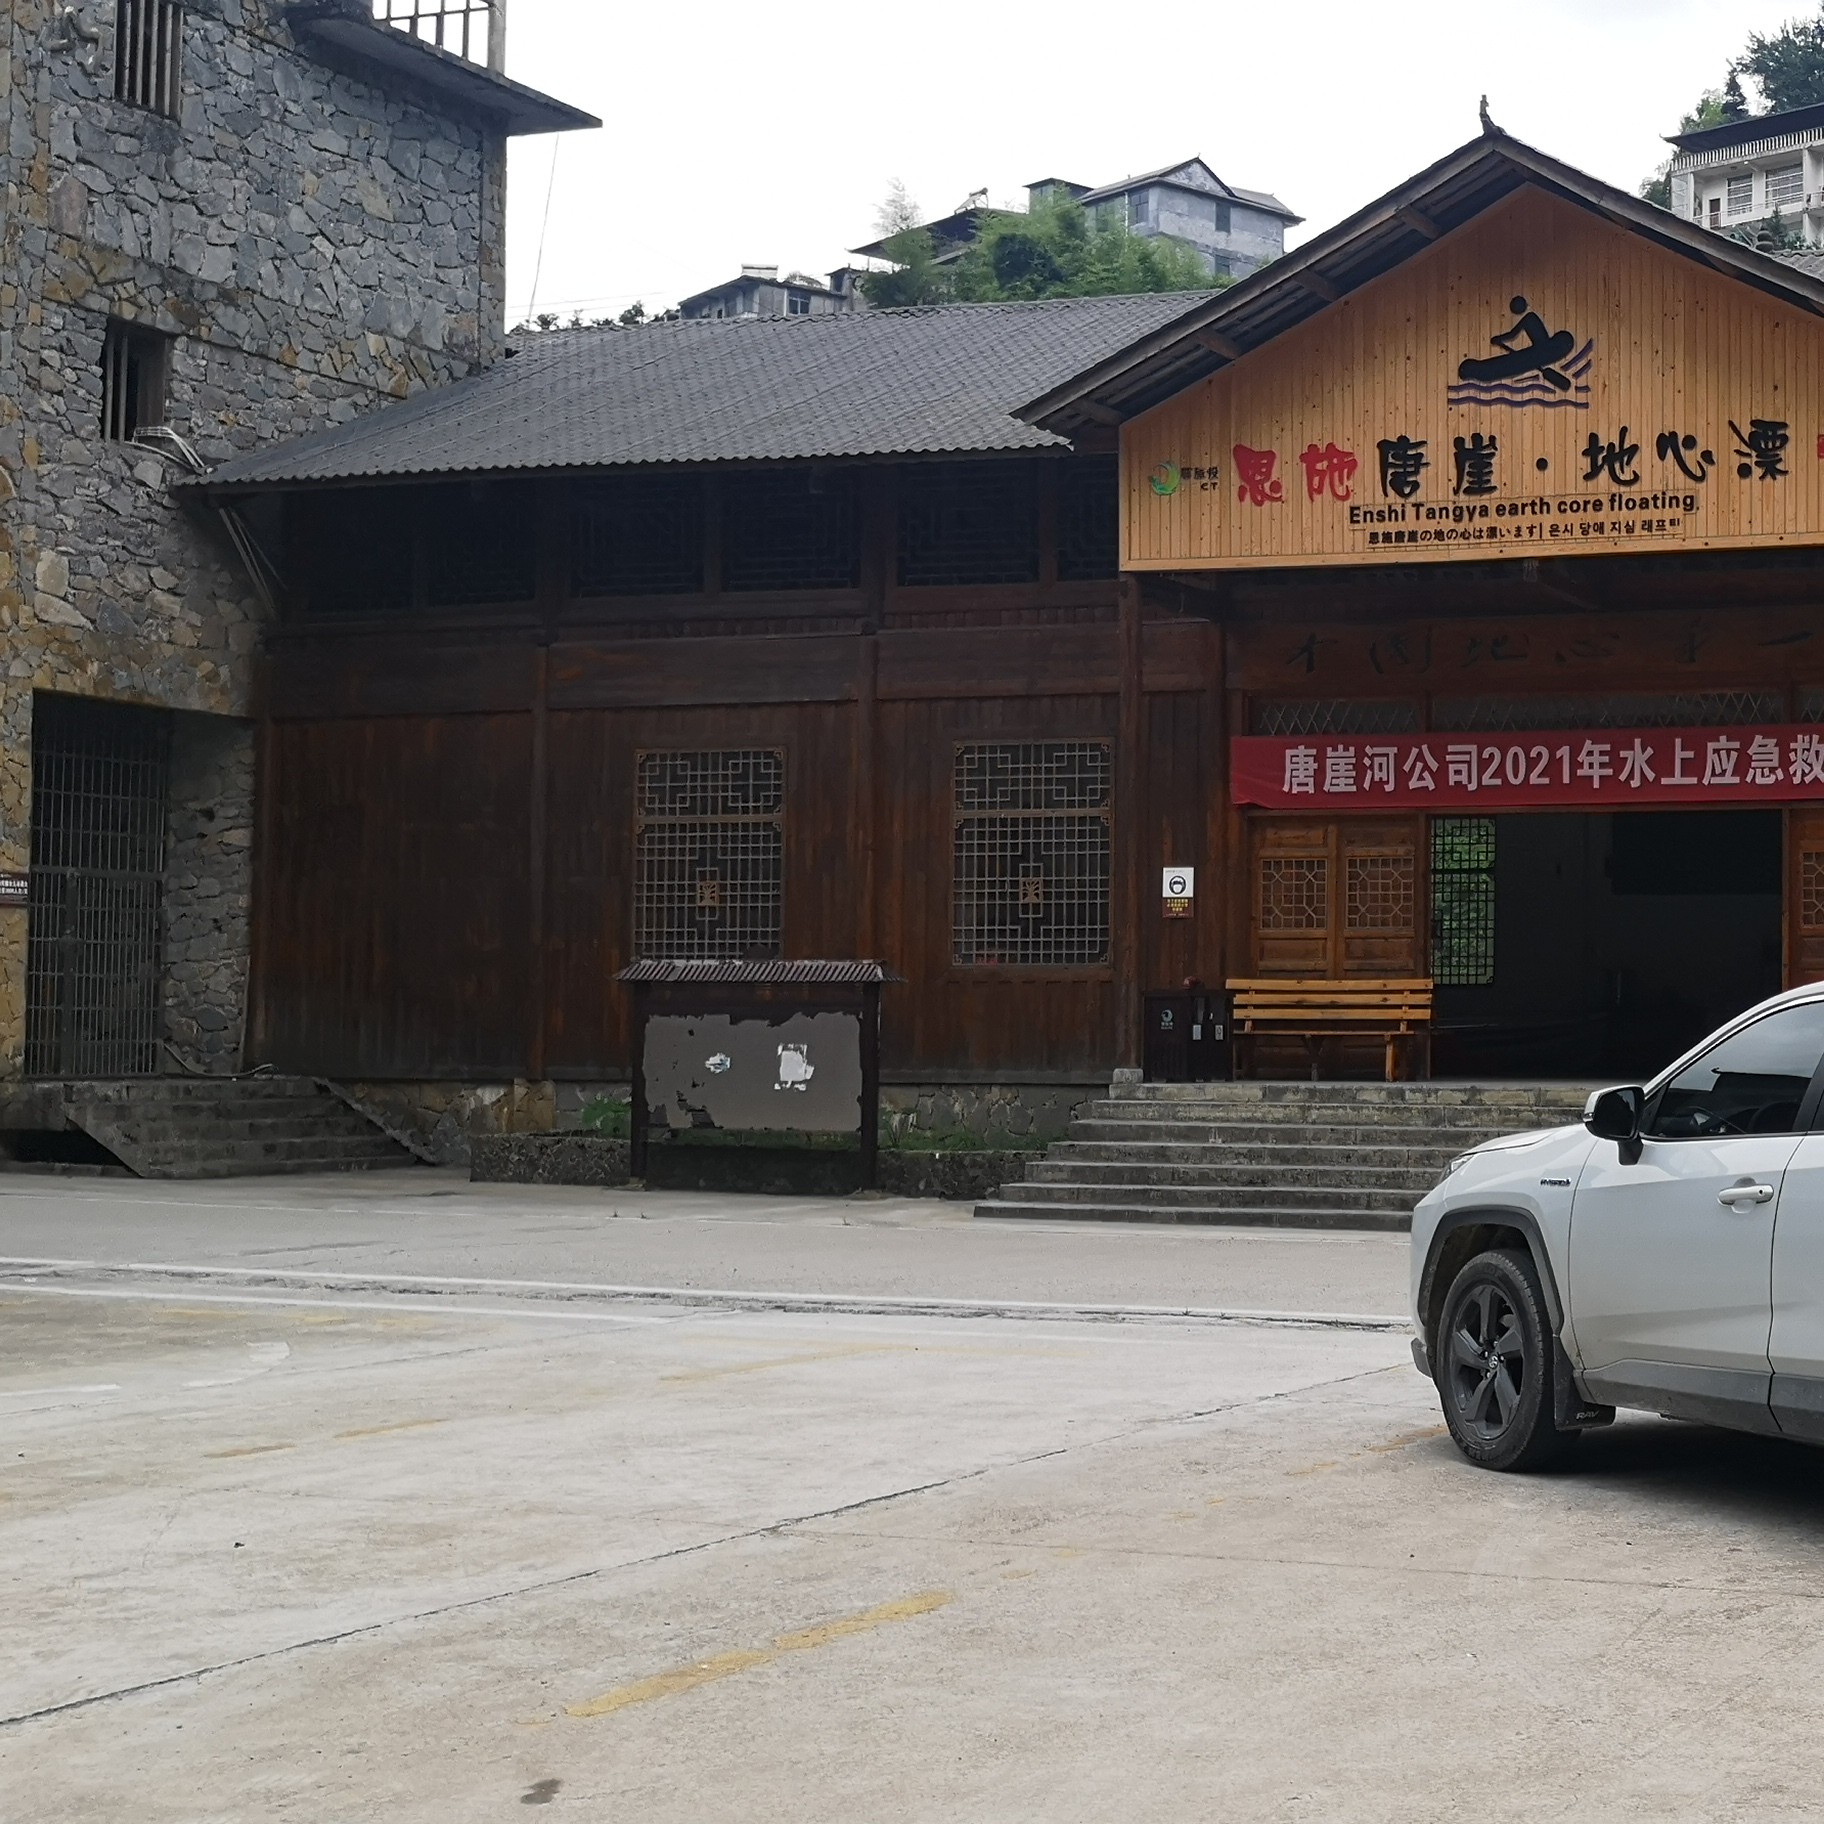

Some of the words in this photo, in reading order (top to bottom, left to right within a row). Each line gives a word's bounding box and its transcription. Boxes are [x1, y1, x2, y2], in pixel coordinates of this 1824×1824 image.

[1350, 504, 1406, 524] Enshi
[1411, 503, 1489, 522] Tangya
[1495, 497, 1551, 517] earth
[1557, 499, 1603, 514] core
[1609, 491, 1695, 513] floating
